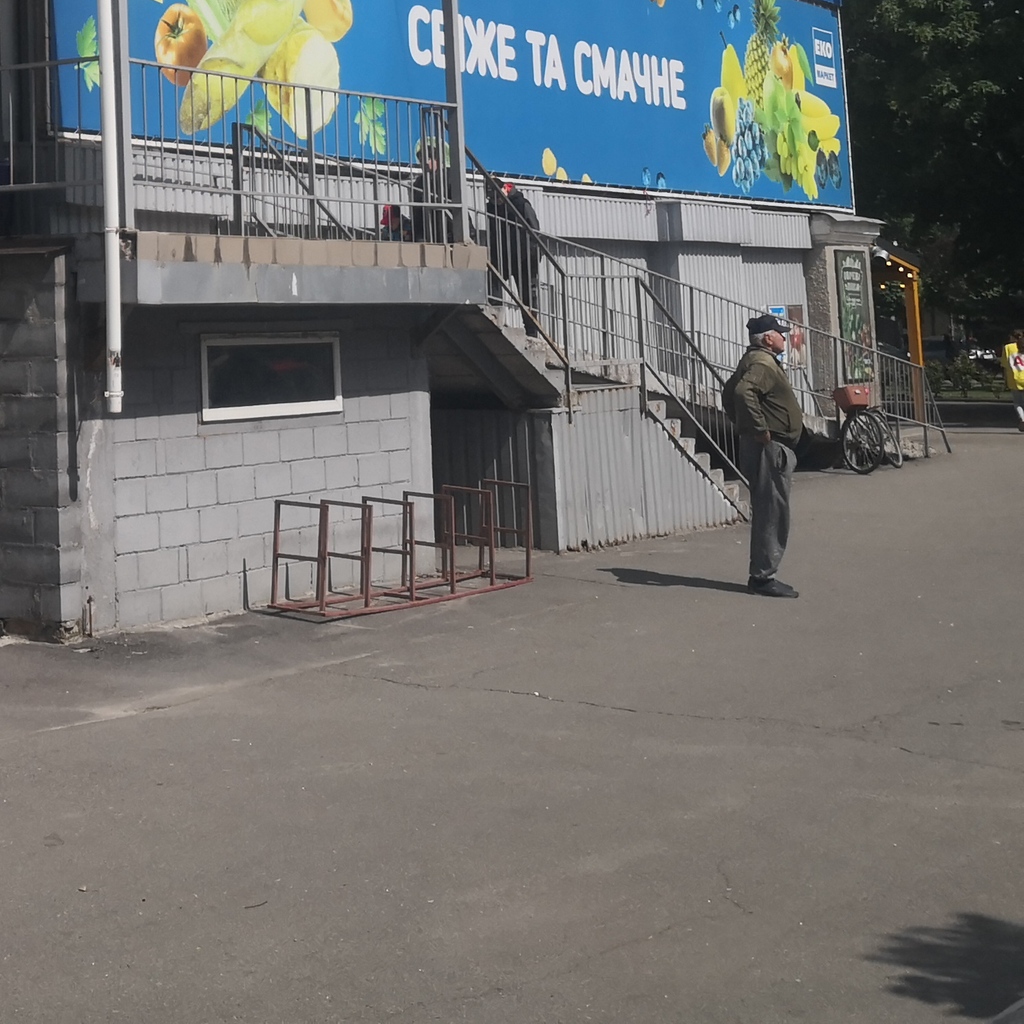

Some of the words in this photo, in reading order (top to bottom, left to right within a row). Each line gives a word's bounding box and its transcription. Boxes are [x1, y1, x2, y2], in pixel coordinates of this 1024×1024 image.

[525, 29, 566, 91] ТА
[574, 40, 687, 110] СМАЧНЕ
[814, 38, 833, 59] ЕКО
